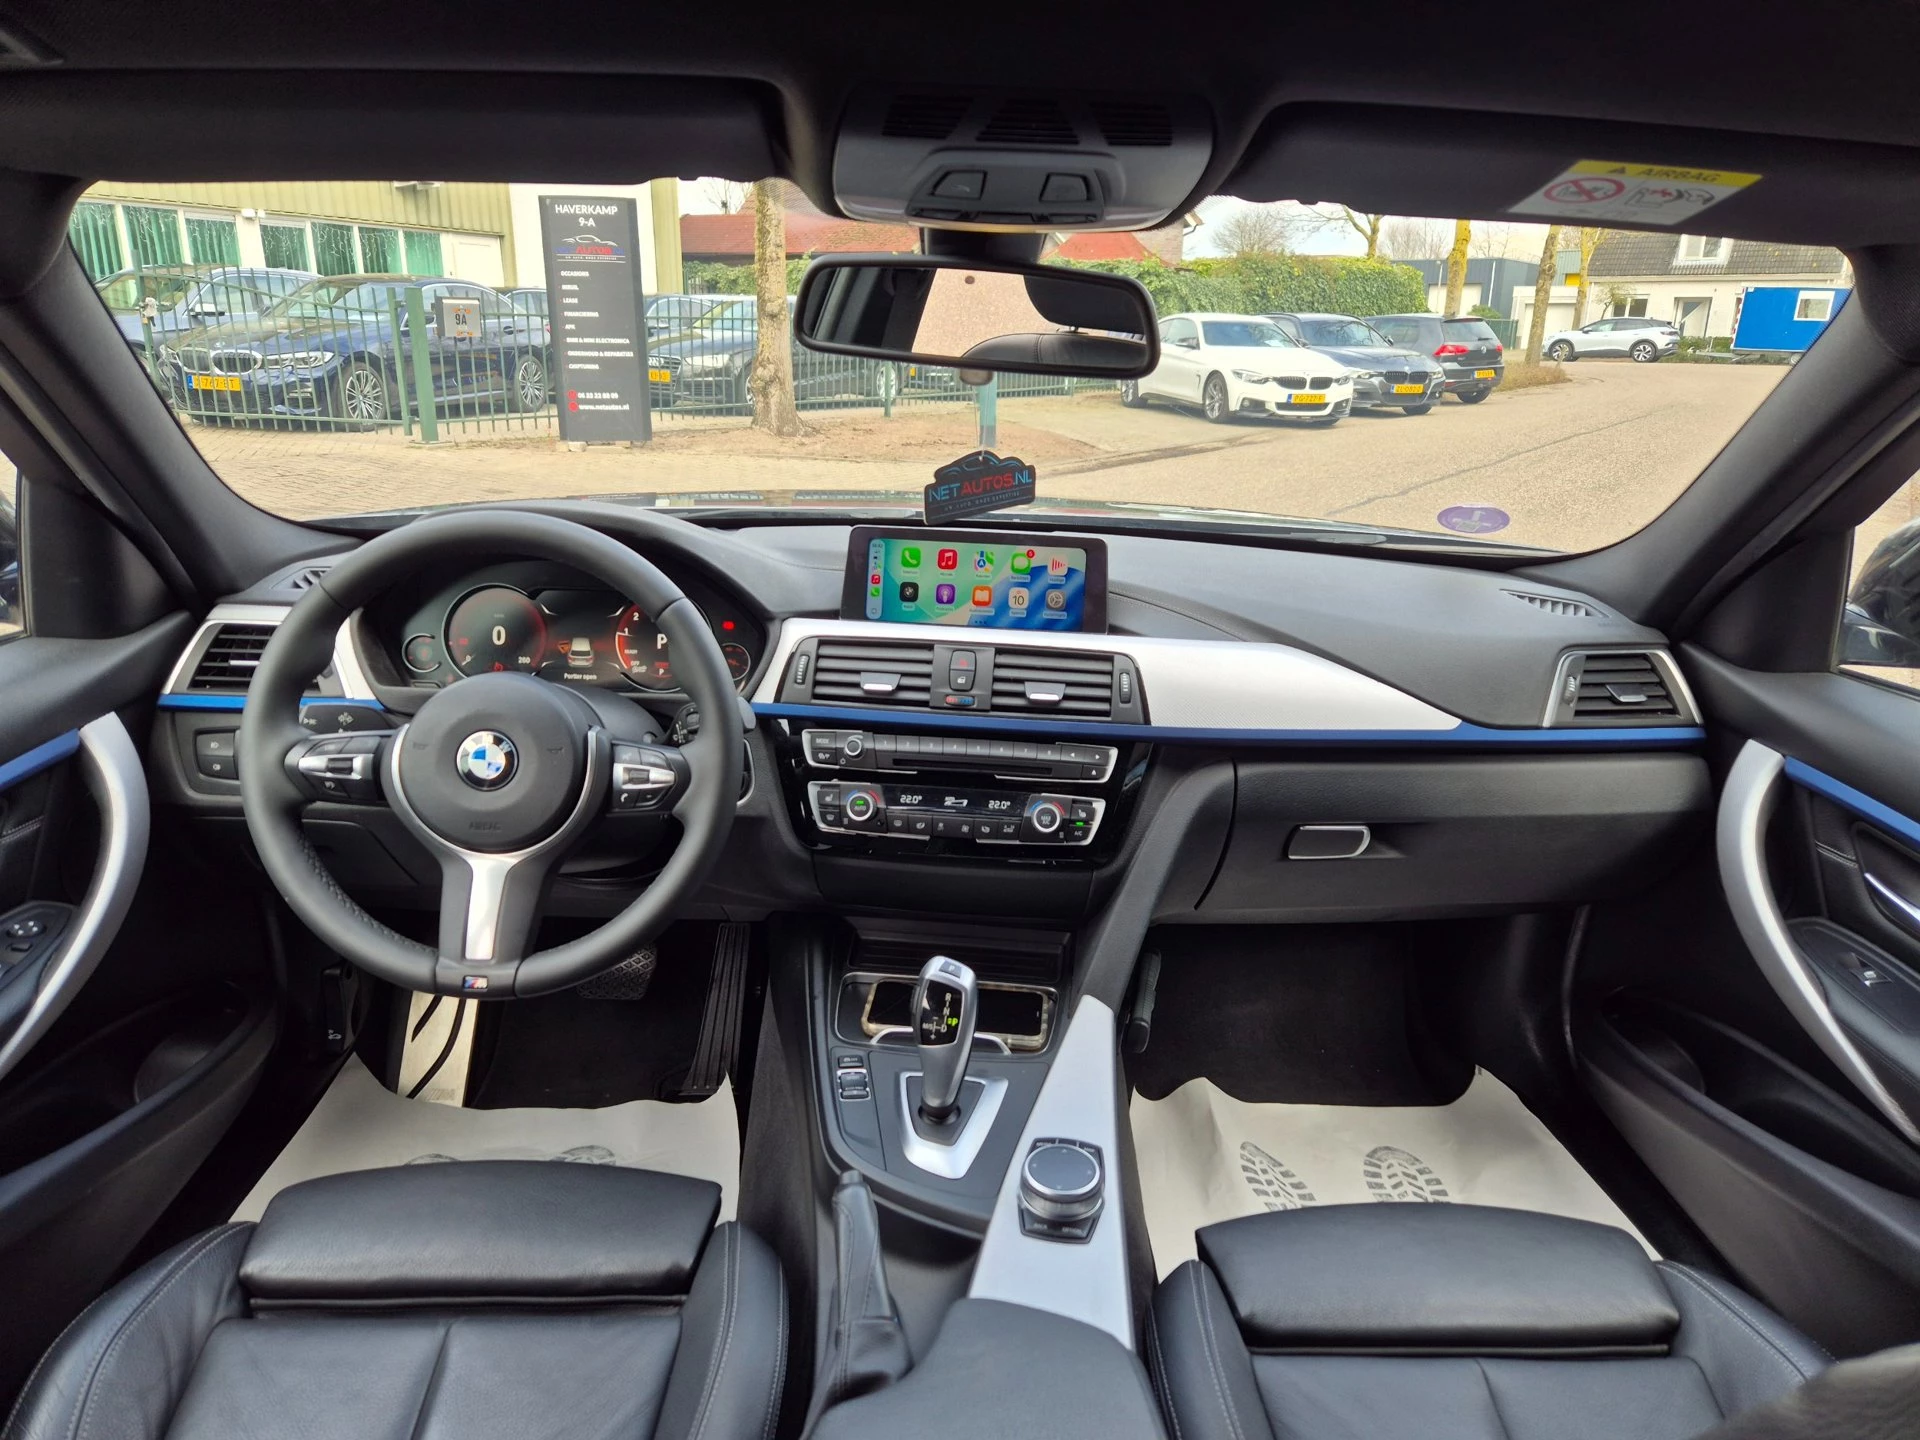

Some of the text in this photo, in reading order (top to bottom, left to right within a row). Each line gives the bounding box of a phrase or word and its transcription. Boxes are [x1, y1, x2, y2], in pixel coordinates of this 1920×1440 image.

[1638, 168, 1722, 183] AIRBAG
[554, 204, 618, 215] HAVERKAMP
[578, 217, 596, 227] 9-A
[455, 313, 467, 325] 9A
[1012, 595, 1025, 606] 10
[633, 612, 640, 621] 2
[492, 625, 506, 646] 0
[656, 633, 668, 650] P
[945, 992, 952, 1001] R
[942, 1007, 950, 1016] N
